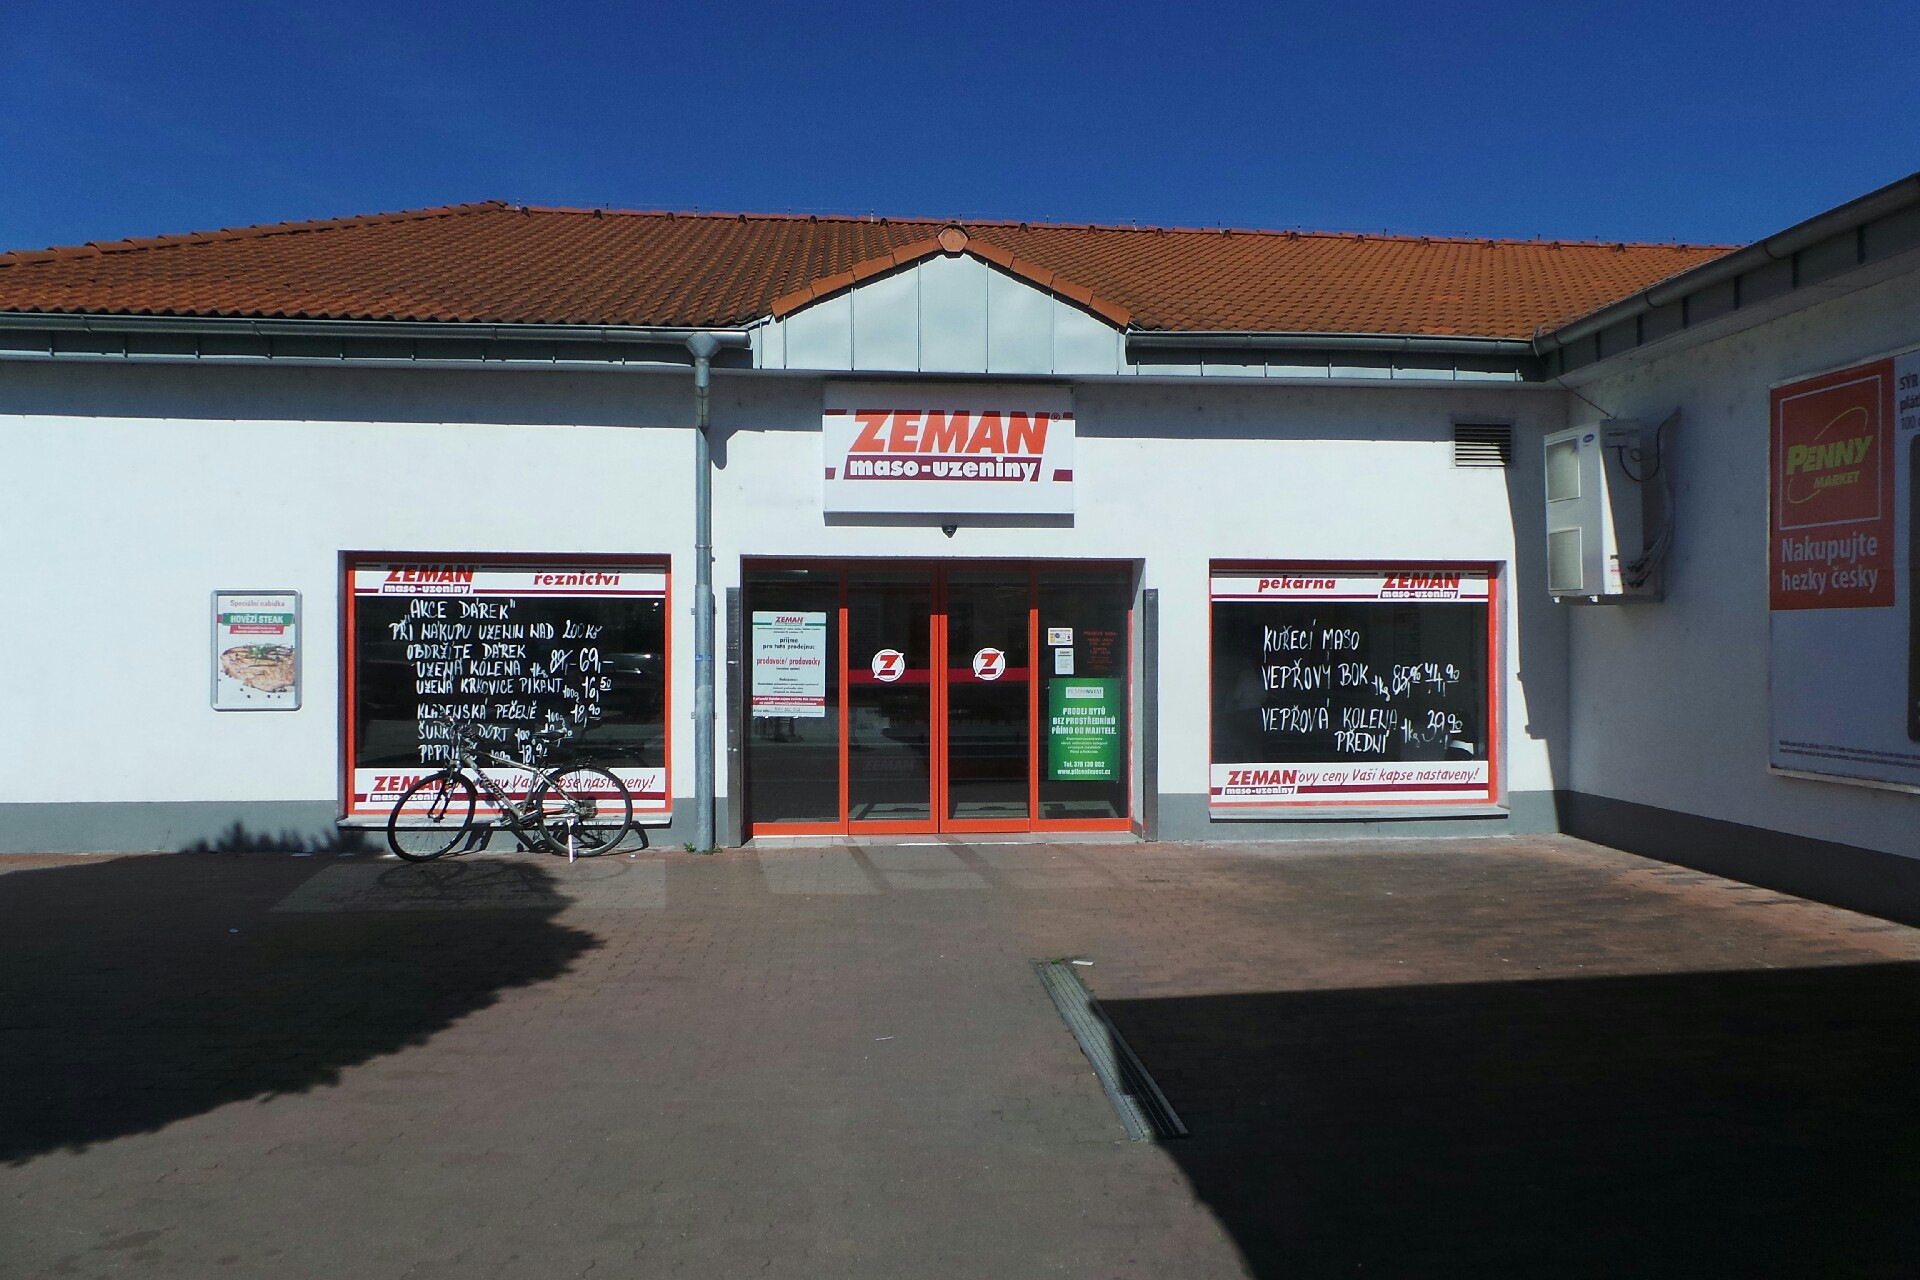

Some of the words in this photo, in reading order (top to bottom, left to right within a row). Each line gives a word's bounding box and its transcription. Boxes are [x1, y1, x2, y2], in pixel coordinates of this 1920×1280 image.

[1786, 435, 1874, 475] PENNY
[849, 456, 1038, 481] maso-uzeniny
[1813, 471, 1860, 488] MARKET
[1782, 532, 1878, 565] Nakupujte
[384, 565, 475, 582] ZEMAN
[533, 570, 620, 585] řeznictví
[1382, 572, 1460, 588] ZEMAN
[1782, 567, 1827, 595] hezky
[1831, 565, 1878, 593] česky
[384, 584, 470, 594] maso-uzeniny
[1258, 575, 1336, 592] pekárna
[1382, 589, 1457, 599] maso-uzeniny
[230, 613, 258, 624] HOVĚZÍ
[258, 615, 284, 624] STEAK
[421, 621, 472, 641] NÁKUPU
[530, 623, 554, 639] NAD
[1263, 619, 1316, 655] KUŘECÍ
[1322, 629, 1360, 650] MASO
[407, 641, 473, 660] OBDRŽÍTE
[482, 642, 526, 660] DÁREK
[470, 660, 521, 676] KOLENA
[1261, 654, 1331, 690] VEPŘOVÝ
[1338, 663, 1368, 686] BOK
[461, 678, 514, 695] KRKOVICE
[519, 677, 563, 694] PIKANT
[495, 700, 537, 719] PEČENĚ
[1063, 707, 1087, 715] PRODEJ
[1261, 698, 1330, 733] VEPŘOVÁ
[1343, 707, 1397, 730] KOLENA
[1053, 717, 1065, 725] BEZ
[1051, 726, 1074, 734] PŘÍMO
[1334, 729, 1389, 753] PŘEDNÍ
[1227, 770, 1298, 785] ZEMAN
[1322, 772, 1349, 786] ceny
[1352, 768, 1379, 781] Vaši
[1378, 768, 1413, 784] kapse
[1416, 767, 1480, 784] nastaveny!
[1225, 786, 1295, 796] maso-uzeniny
